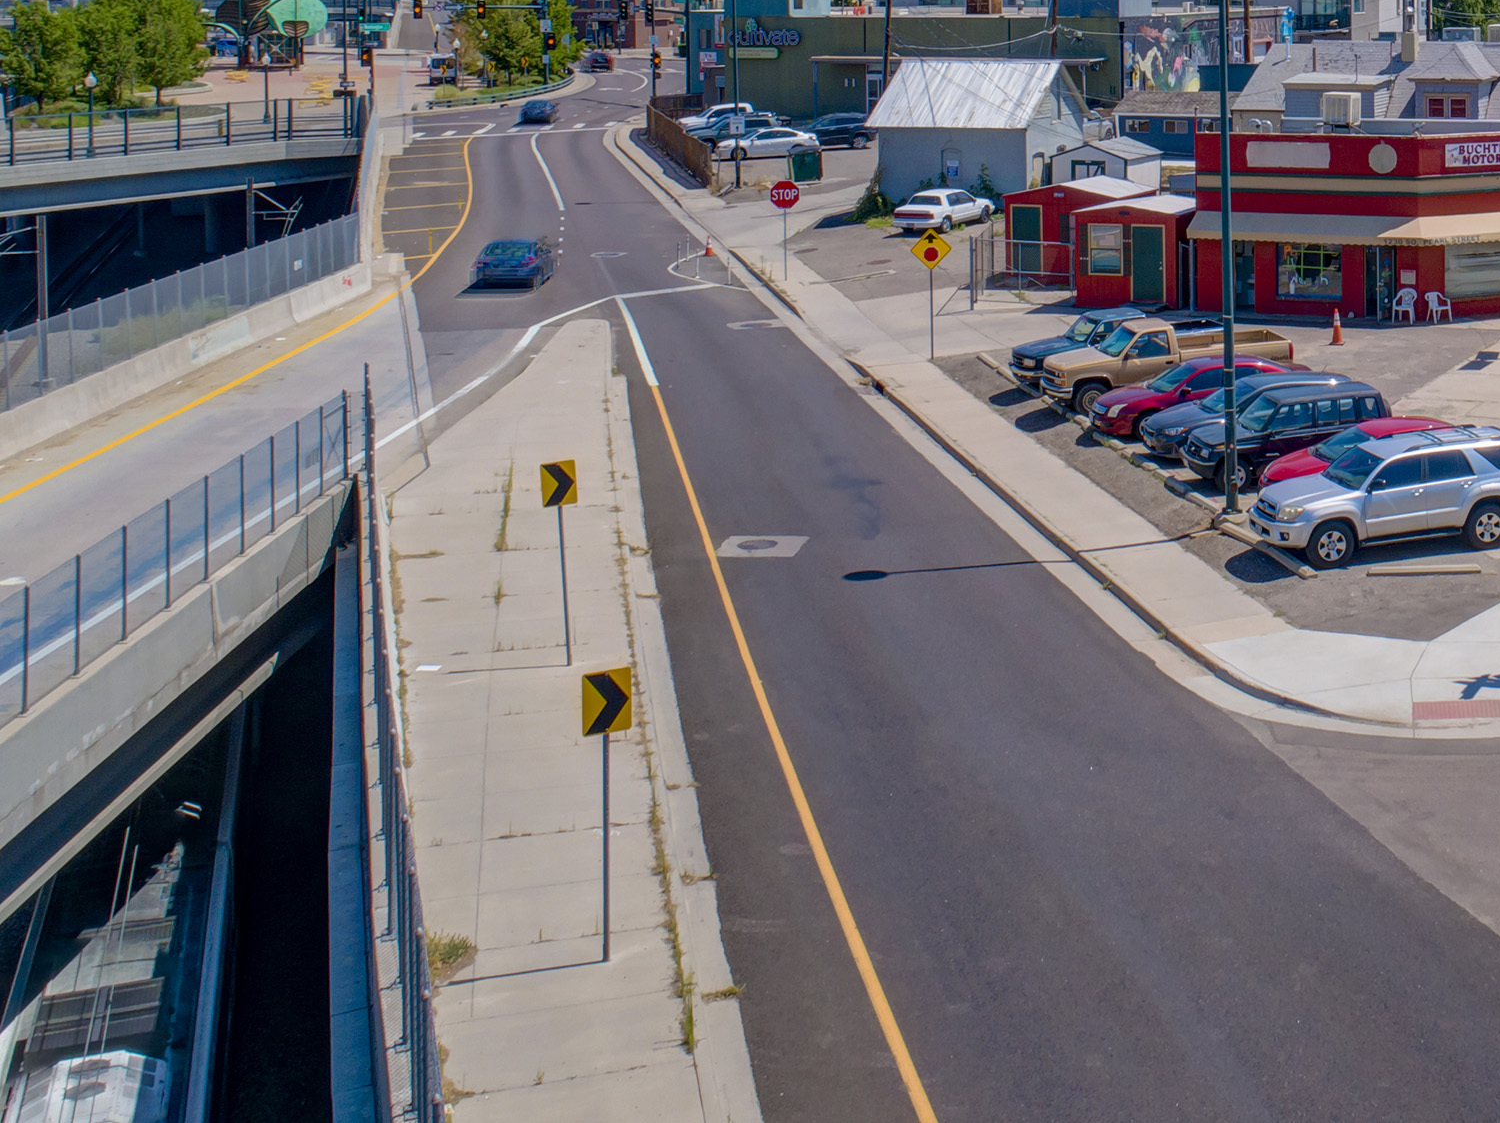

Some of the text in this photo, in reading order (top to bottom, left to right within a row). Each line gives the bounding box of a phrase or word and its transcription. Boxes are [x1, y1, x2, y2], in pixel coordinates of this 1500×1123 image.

[728, 27, 800, 46] cultivate
[770, 189, 799, 201] STOP
[1423, 237, 1449, 247] PEARL
[1451, 234, 1481, 244] STREET
